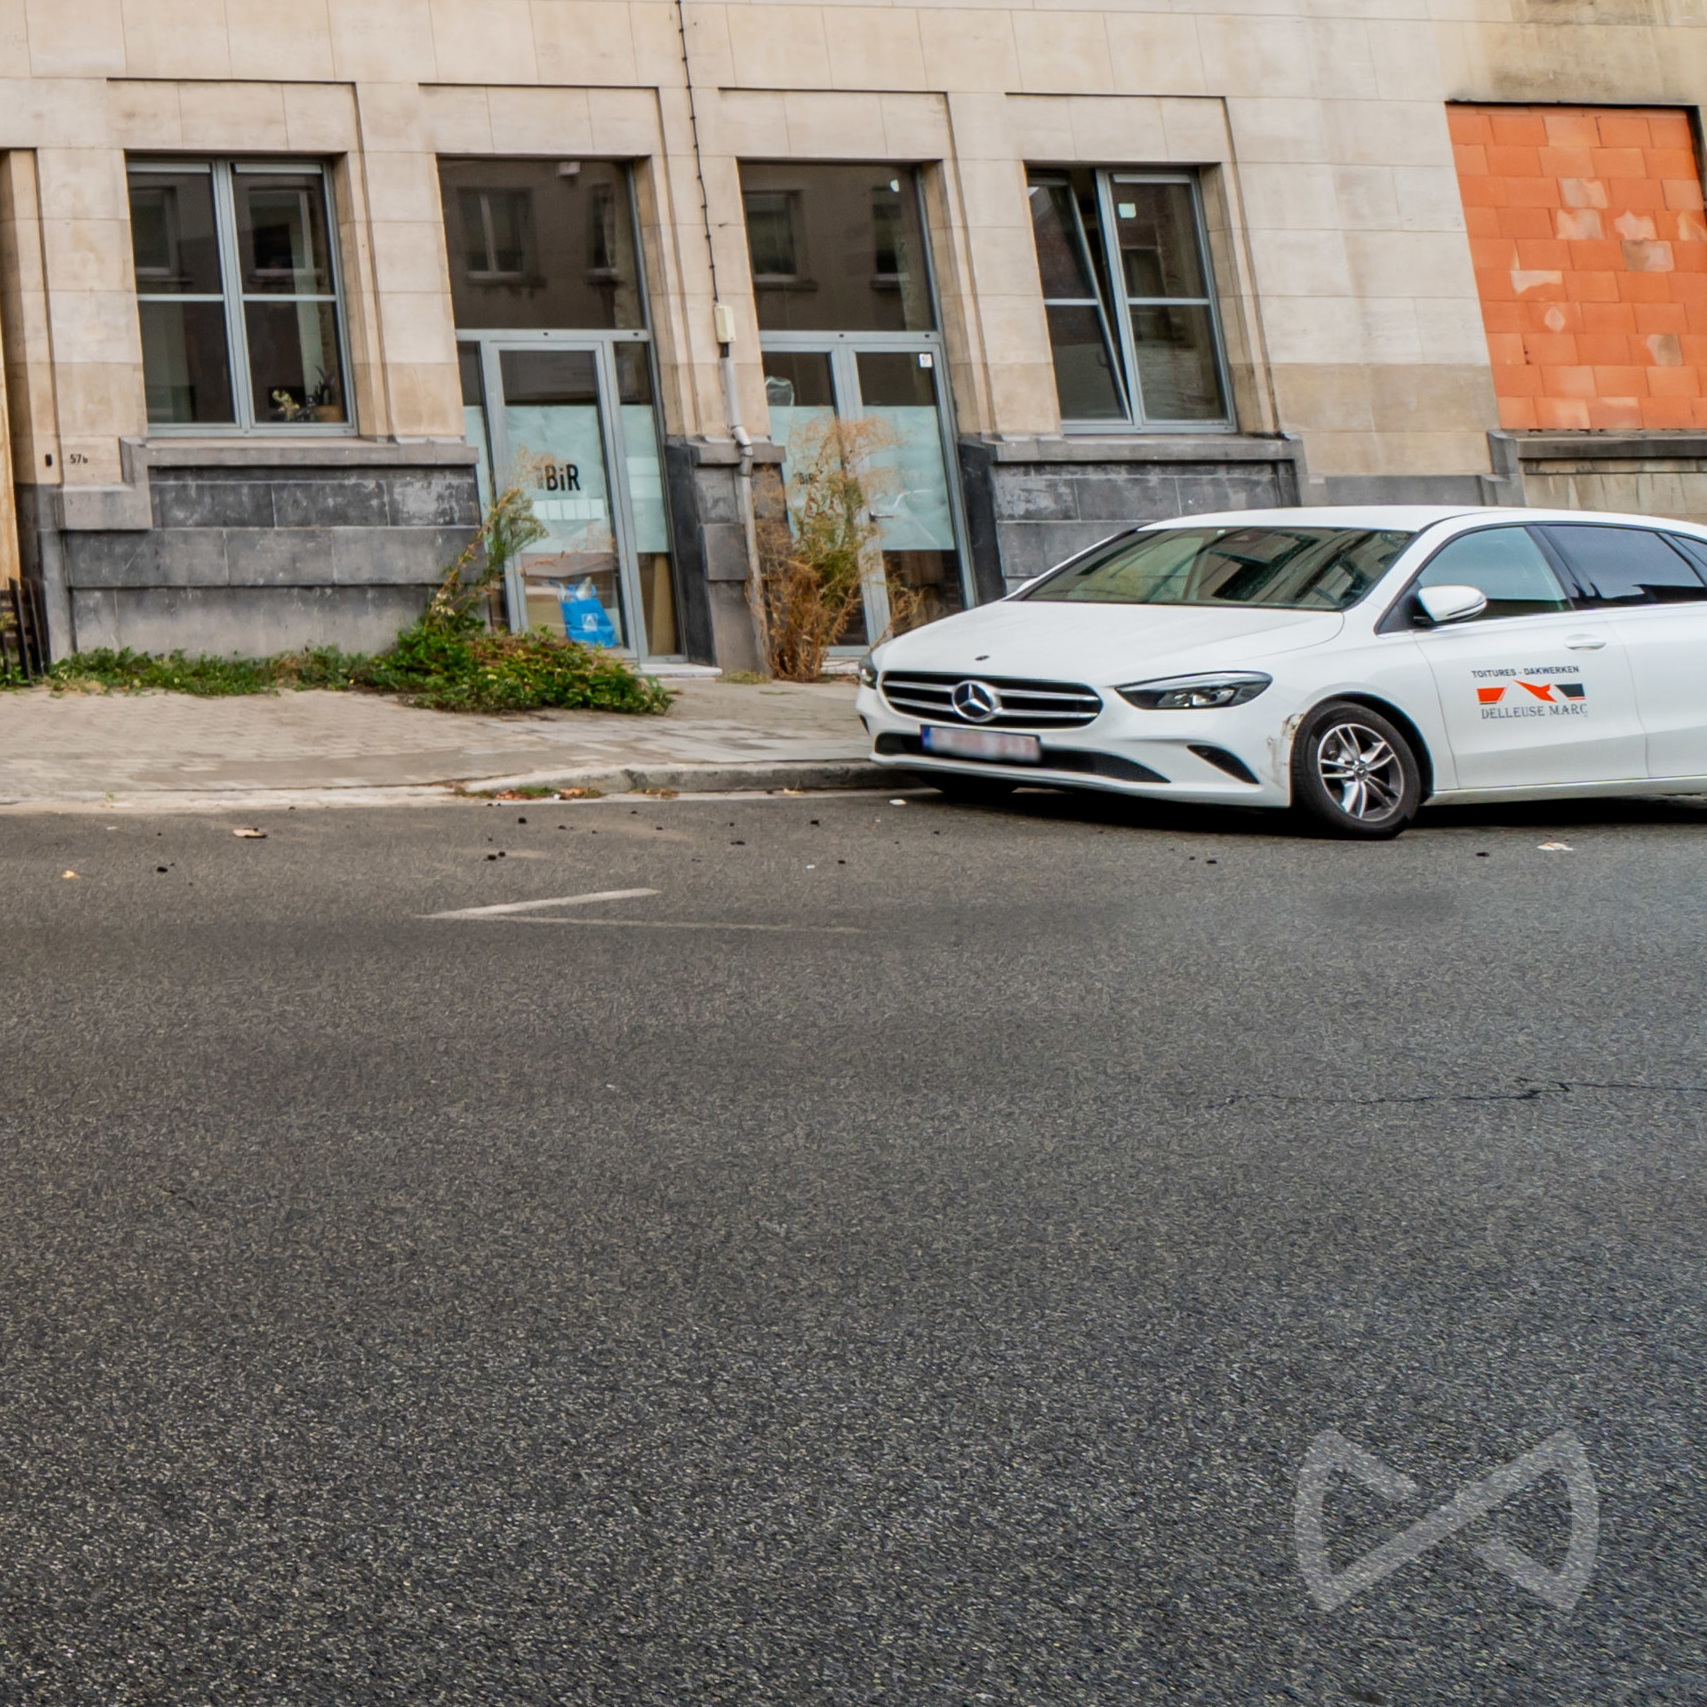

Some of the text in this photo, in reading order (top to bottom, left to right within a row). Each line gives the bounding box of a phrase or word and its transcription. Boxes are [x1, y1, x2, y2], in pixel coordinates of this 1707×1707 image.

[544, 463, 581, 491] BiR
[1471, 668, 1517, 678] TOITURES
[1523, 665, 1580, 676] DAKWERKEN
[1481, 703, 1588, 719] DELLEUSE MARC
